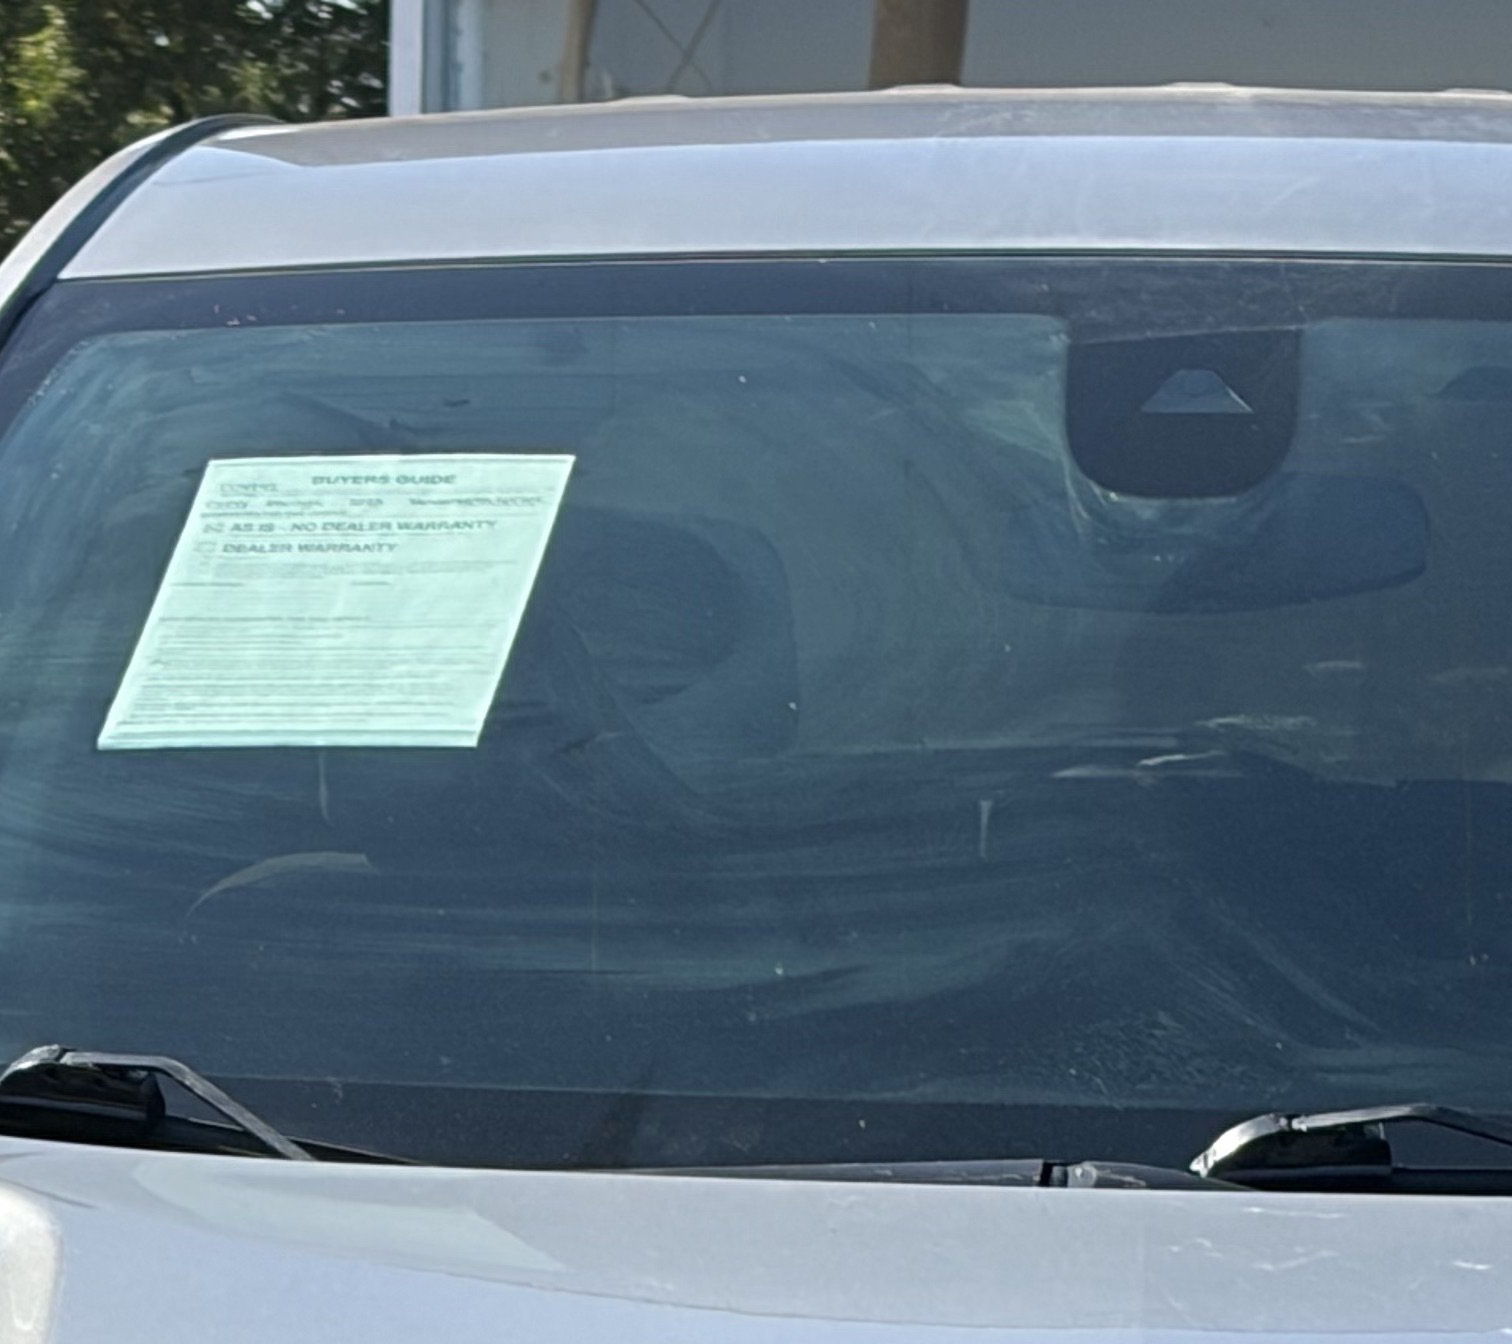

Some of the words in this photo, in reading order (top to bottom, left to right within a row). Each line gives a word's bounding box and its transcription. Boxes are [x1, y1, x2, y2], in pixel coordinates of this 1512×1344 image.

[312, 475, 390, 485] BUYERS
[396, 474, 457, 485] GUIDE
[322, 521, 393, 533] DEALER
[397, 519, 499, 532] WARRANTY
[222, 543, 293, 554] DEALER
[297, 542, 399, 554] WARRANTY
